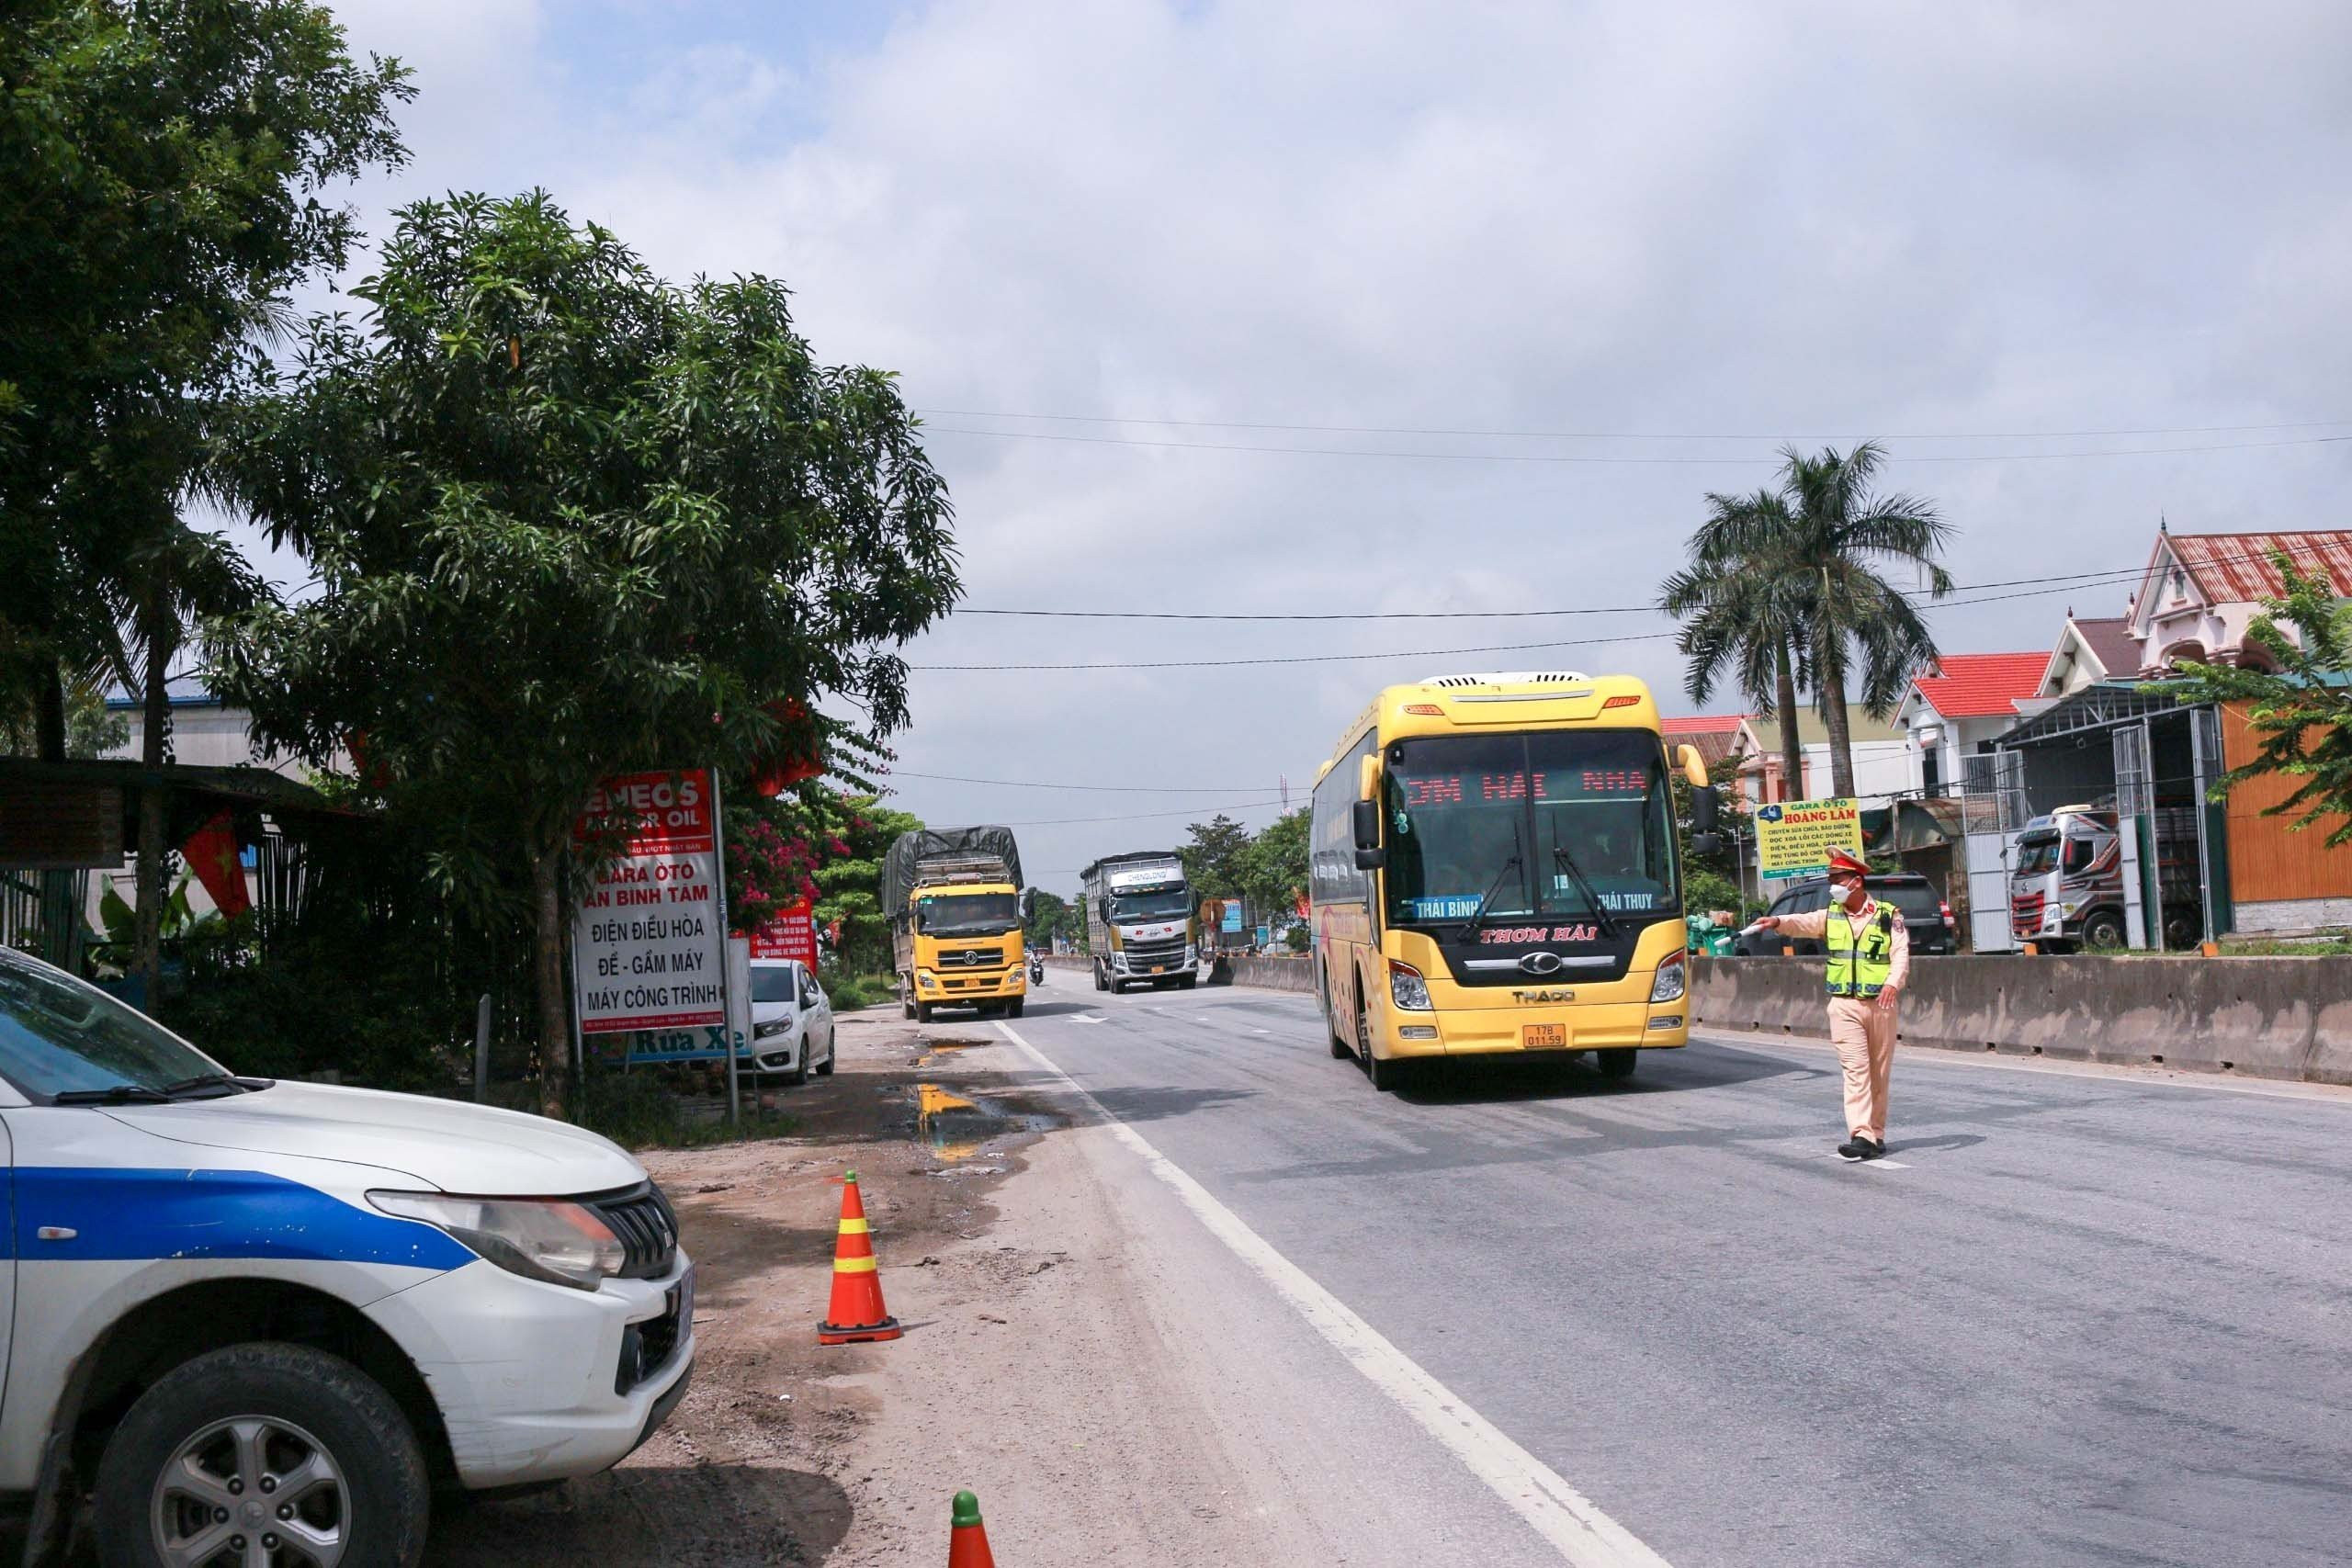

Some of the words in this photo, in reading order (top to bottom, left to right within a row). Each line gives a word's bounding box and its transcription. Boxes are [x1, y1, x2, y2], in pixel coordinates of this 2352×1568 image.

[585, 781, 699, 813] ENEOS
[1790, 802, 1821, 810] GARA
[667, 809, 701, 827] OIL
[1784, 809, 1827, 825] HOÀNG
[1830, 807, 1856, 820] LÂM
[616, 886, 662, 907] BÌNH
[668, 883, 709, 903] TÂM
[1597, 891, 1622, 910] THÁI
[1416, 898, 1445, 919] THÁI
[1448, 897, 1479, 918] BÌNH
[592, 918, 628, 947] ĐIỆN
[672, 912, 705, 938] HÒA
[1480, 927, 1548, 944] THƠM
[672, 948, 704, 973] MÁY
[588, 987, 620, 1011] MÁY
[624, 985, 669, 1009] CÔNG
[672, 982, 717, 1006] TRÌNH
[1512, 990, 1576, 1004] THACO
[705, 1025, 744, 1052] Xe
